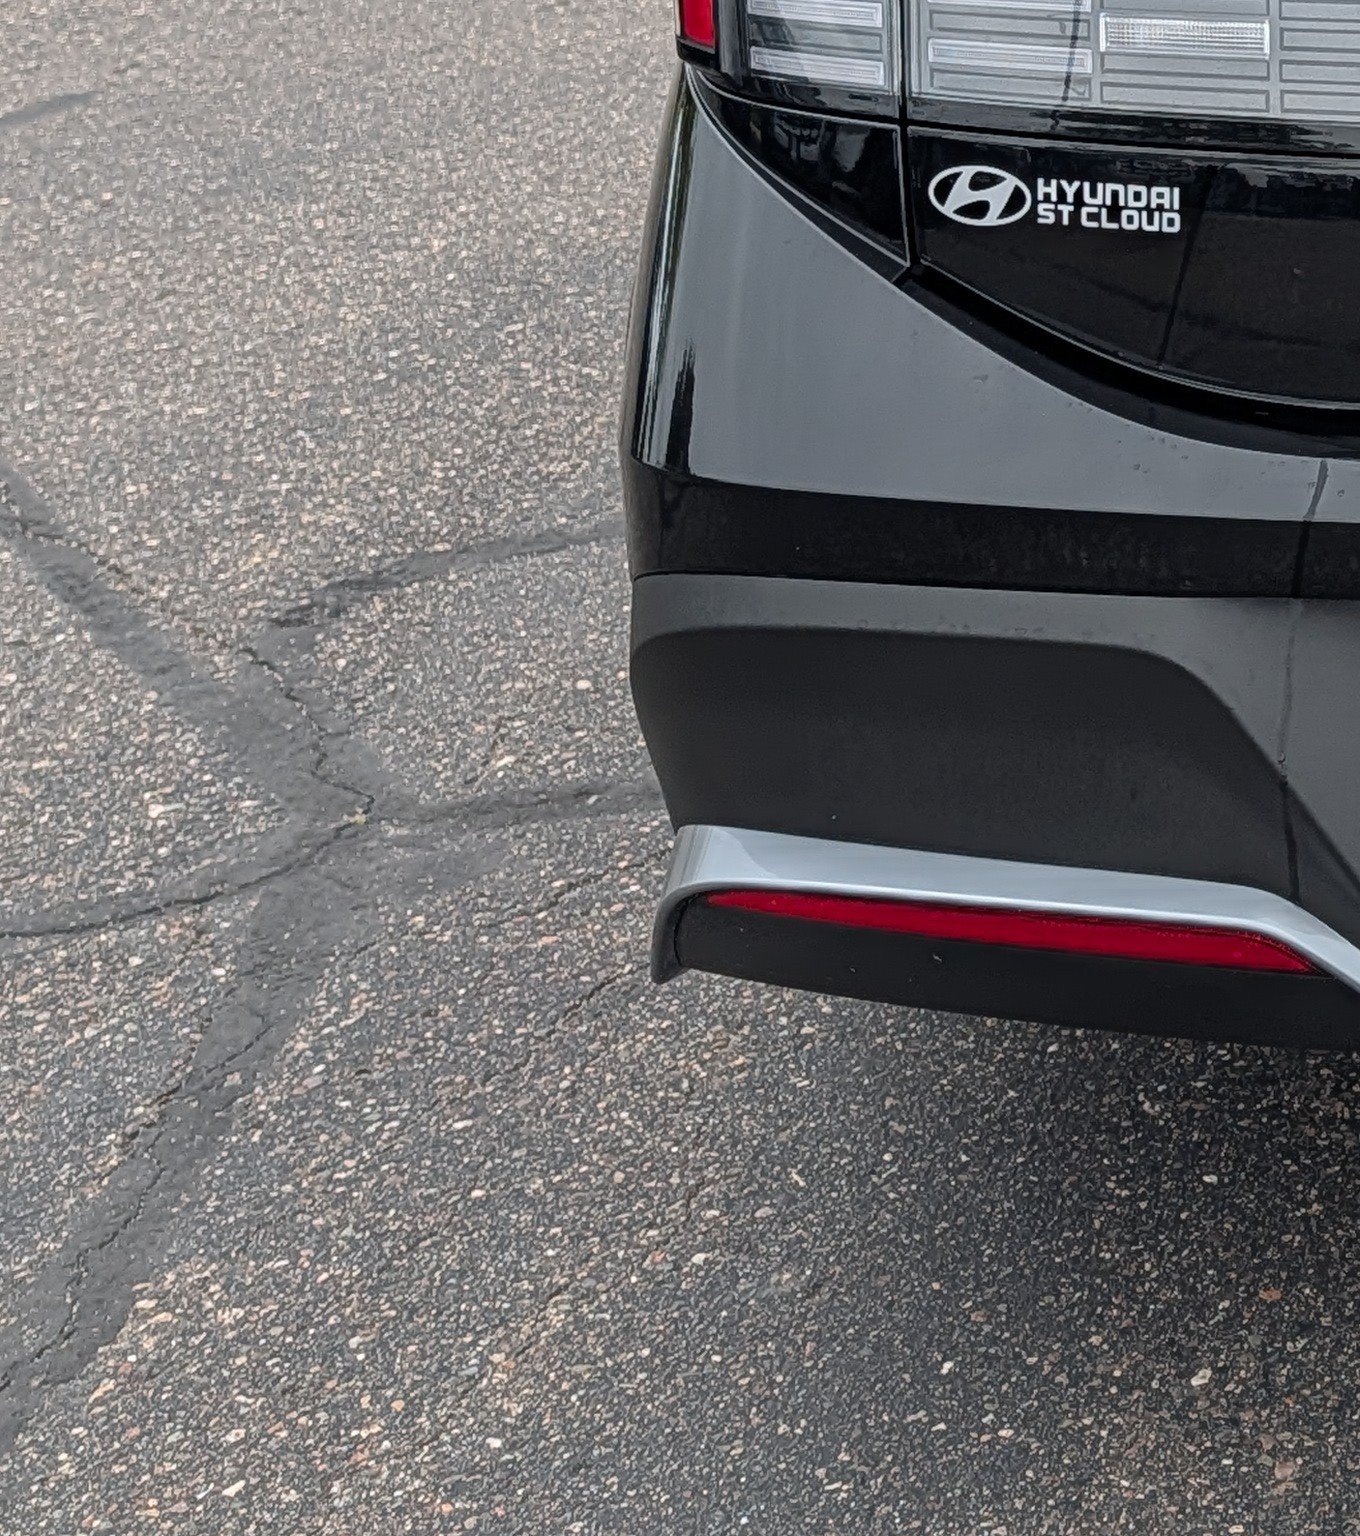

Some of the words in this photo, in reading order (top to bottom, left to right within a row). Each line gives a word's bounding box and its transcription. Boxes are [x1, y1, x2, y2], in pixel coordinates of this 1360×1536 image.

[1036, 177, 1181, 211] HYUNDAI
[1036, 202, 1074, 226] ST
[1080, 206, 1182, 234] CLOUD
